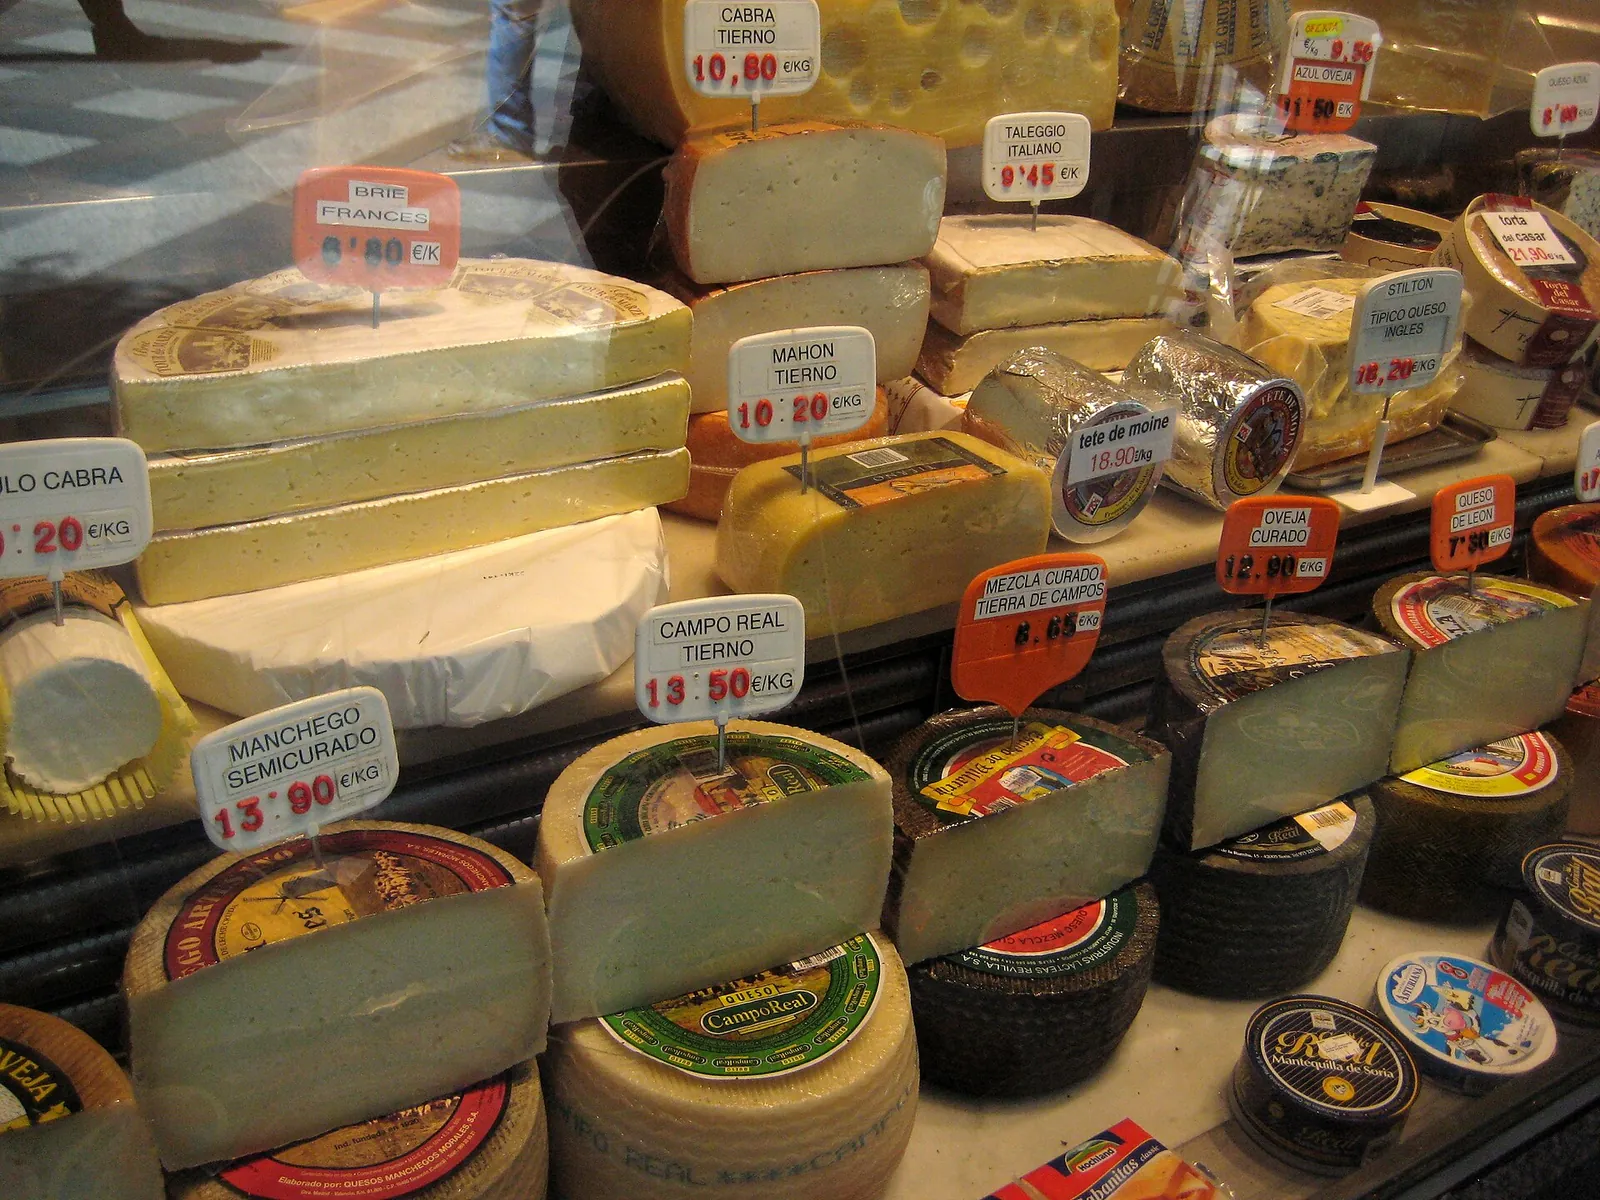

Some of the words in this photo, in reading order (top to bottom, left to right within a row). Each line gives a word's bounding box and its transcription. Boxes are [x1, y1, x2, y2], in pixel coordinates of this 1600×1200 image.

[721, 7, 775, 22] CABRA
[718, 29, 775, 44] TIERNO
[783, 60, 810, 72] €/KG
[1295, 67, 1319, 80] AZUL
[1322, 69, 1352, 82] OVEJA
[1005, 124, 1066, 139] TALEGGIO
[1008, 141, 1062, 157] ITALIANO
[1061, 167, 1079, 180] €/K
[355, 186, 405, 199] BRIE
[322, 206, 428, 224] FRANCES
[1499, 214, 1528, 227] torta
[1502, 234, 1514, 243] del
[1515, 231, 1547, 243] casar
[412, 244, 440, 261] €/K
[1388, 278, 1434, 296] STILTON
[1541, 280, 1569, 291] Torta
[1554, 288, 1569, 298] del
[1550, 295, 1580, 307] Casar
[1370, 308, 1406, 325] TIPICO
[1408, 301, 1447, 318] QUESO
[1384, 323, 1425, 338] INGLES
[773, 342, 834, 364] MAHON
[775, 365, 838, 385] TIERNO
[832, 394, 862, 409] €/KG
[1079, 430, 1105, 449] tete
[1108, 424, 1126, 441] de
[1128, 415, 1170, 437] moine
[44, 466, 124, 490] CABRA
[1459, 488, 1493, 508] QUESO
[1265, 511, 1307, 524] OVEJA
[1452, 516, 1466, 529] DE
[1467, 508, 1493, 524] LEON
[88, 520, 130, 539] €/KG
[1252, 529, 1307, 543] CURADO
[1490, 527, 1512, 544] €/KG
[1300, 561, 1323, 573] €/KG
[986, 573, 1040, 595] MEZCLA
[1045, 566, 1099, 586] CURADO
[978, 595, 1026, 616] TIERRA
[1030, 591, 1048, 607] DE
[1051, 582, 1105, 604] CAMPOS
[660, 616, 731, 640] CAMPO
[737, 611, 785, 632] REAL
[683, 639, 754, 662] TIERNO
[750, 672, 793, 693] €/KG
[230, 706, 361, 763] MANCHEGO
[228, 726, 376, 790] SEMICURADO
[340, 765, 379, 788] €/KG
[1062, 909, 1088, 935] QUESO
[1018, 930, 1064, 945] MEZCLA
[1082, 931, 1124, 964] INDUSTRIAS
[960, 953, 980, 966] S.A.
[1395, 966, 1423, 1004] ASTURIANA
[725, 986, 773, 1004] QUESO
[707, 990, 808, 1031] CampoReal
[1271, 1055, 1344, 1072] Mantequilla
[1346, 1064, 1362, 1074] de
[1363, 1066, 1395, 1079] Soria
[334, 1140, 351, 1151] Ind.
[352, 1130, 387, 1146] fundada
[387, 1124, 399, 1134] en
[278, 1176, 322, 1188] Elaborado
[324, 1181, 342, 1189] por:
[343, 1176, 384, 1189] QUESOS
[385, 1150, 441, 1182] MANCHEGOS
[439, 1121, 472, 1153] MORALES,
[467, 1109, 479, 1123] S.A.
[1078, 1146, 1116, 1172] Hochland
